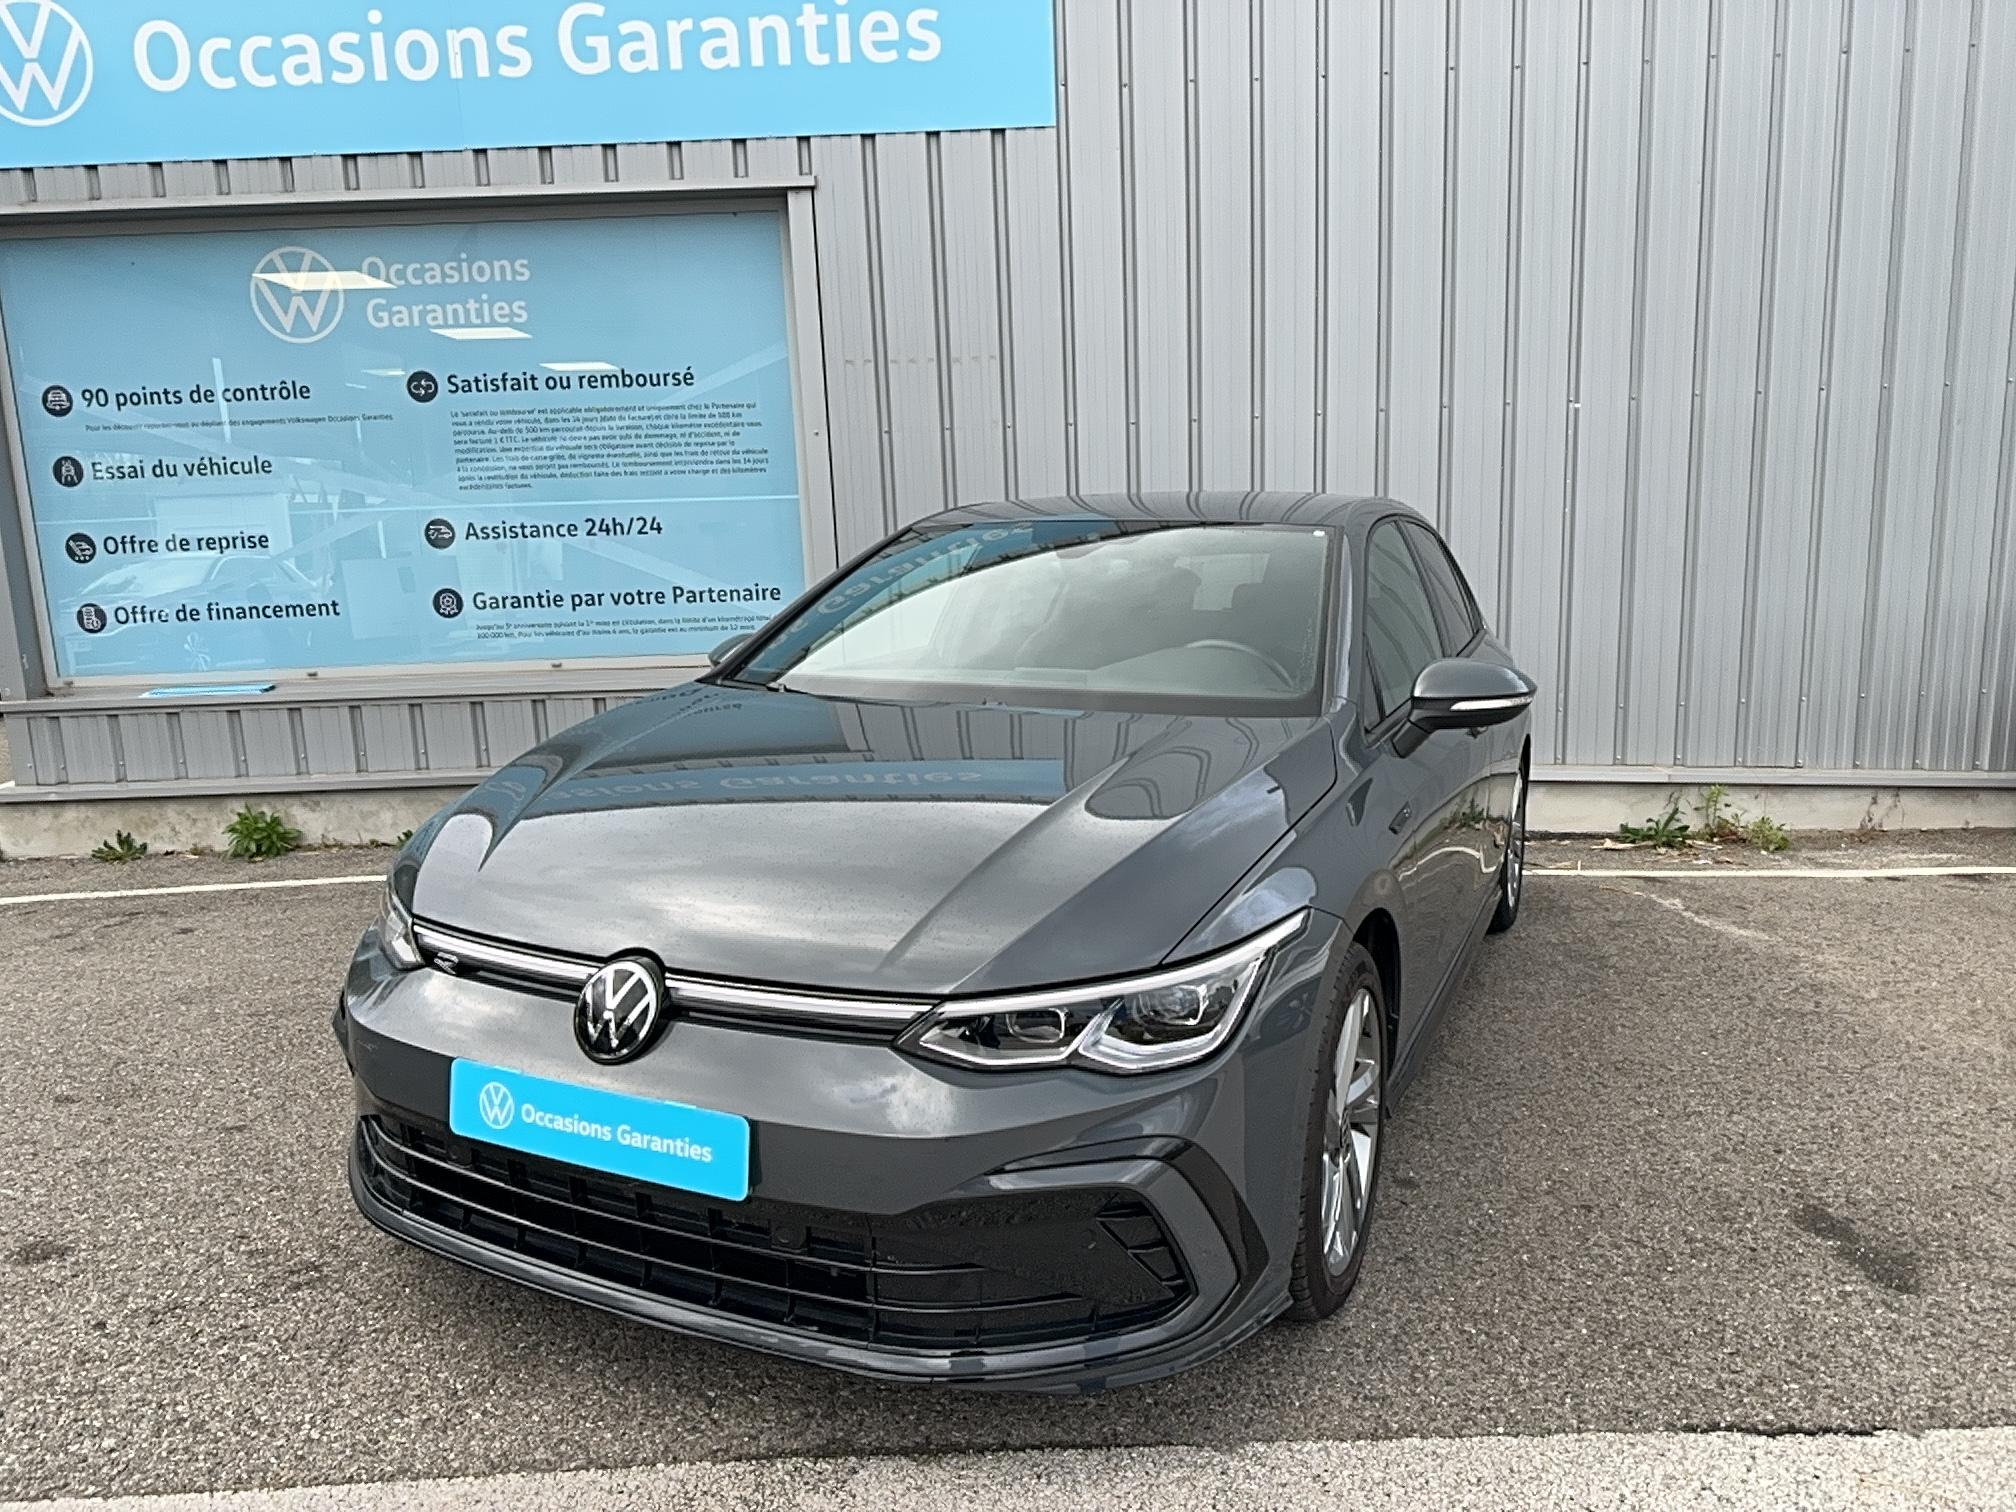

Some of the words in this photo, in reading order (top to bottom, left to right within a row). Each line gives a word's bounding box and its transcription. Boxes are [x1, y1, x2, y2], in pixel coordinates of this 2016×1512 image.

[134, 10, 532, 91] Occasions
[558, 0, 941, 74] Garanties
[361, 253, 531, 287] Occasions
[367, 293, 529, 328] Garanties
[447, 372, 538, 393] Satisfait
[545, 376, 570, 390] ou
[579, 366, 694, 389] remboursé
[82, 388, 108, 407] 90
[116, 386, 182, 411] points
[190, 384, 214, 403] de
[223, 381, 310, 402] contrôle
[92, 460, 144, 479] Essai
[152, 459, 177, 478] du
[184, 455, 272, 476] véhicule
[466, 521, 578, 540] Assistance
[585, 517, 662, 536] 24h/24
[104, 535, 158, 554] Offre
[166, 534, 190, 552] de
[197, 532, 268, 554] reprise
[473, 590, 564, 610] Garantie
[571, 593, 604, 611] par
[610, 590, 665, 605] votre
[673, 583, 780, 603] Partenaire
[115, 606, 168, 624] Offre
[176, 604, 200, 622] de
[207, 601, 340, 620] financement
[521, 1104, 613, 1141] Occasions
[616, 1124, 712, 1162] Garanties
